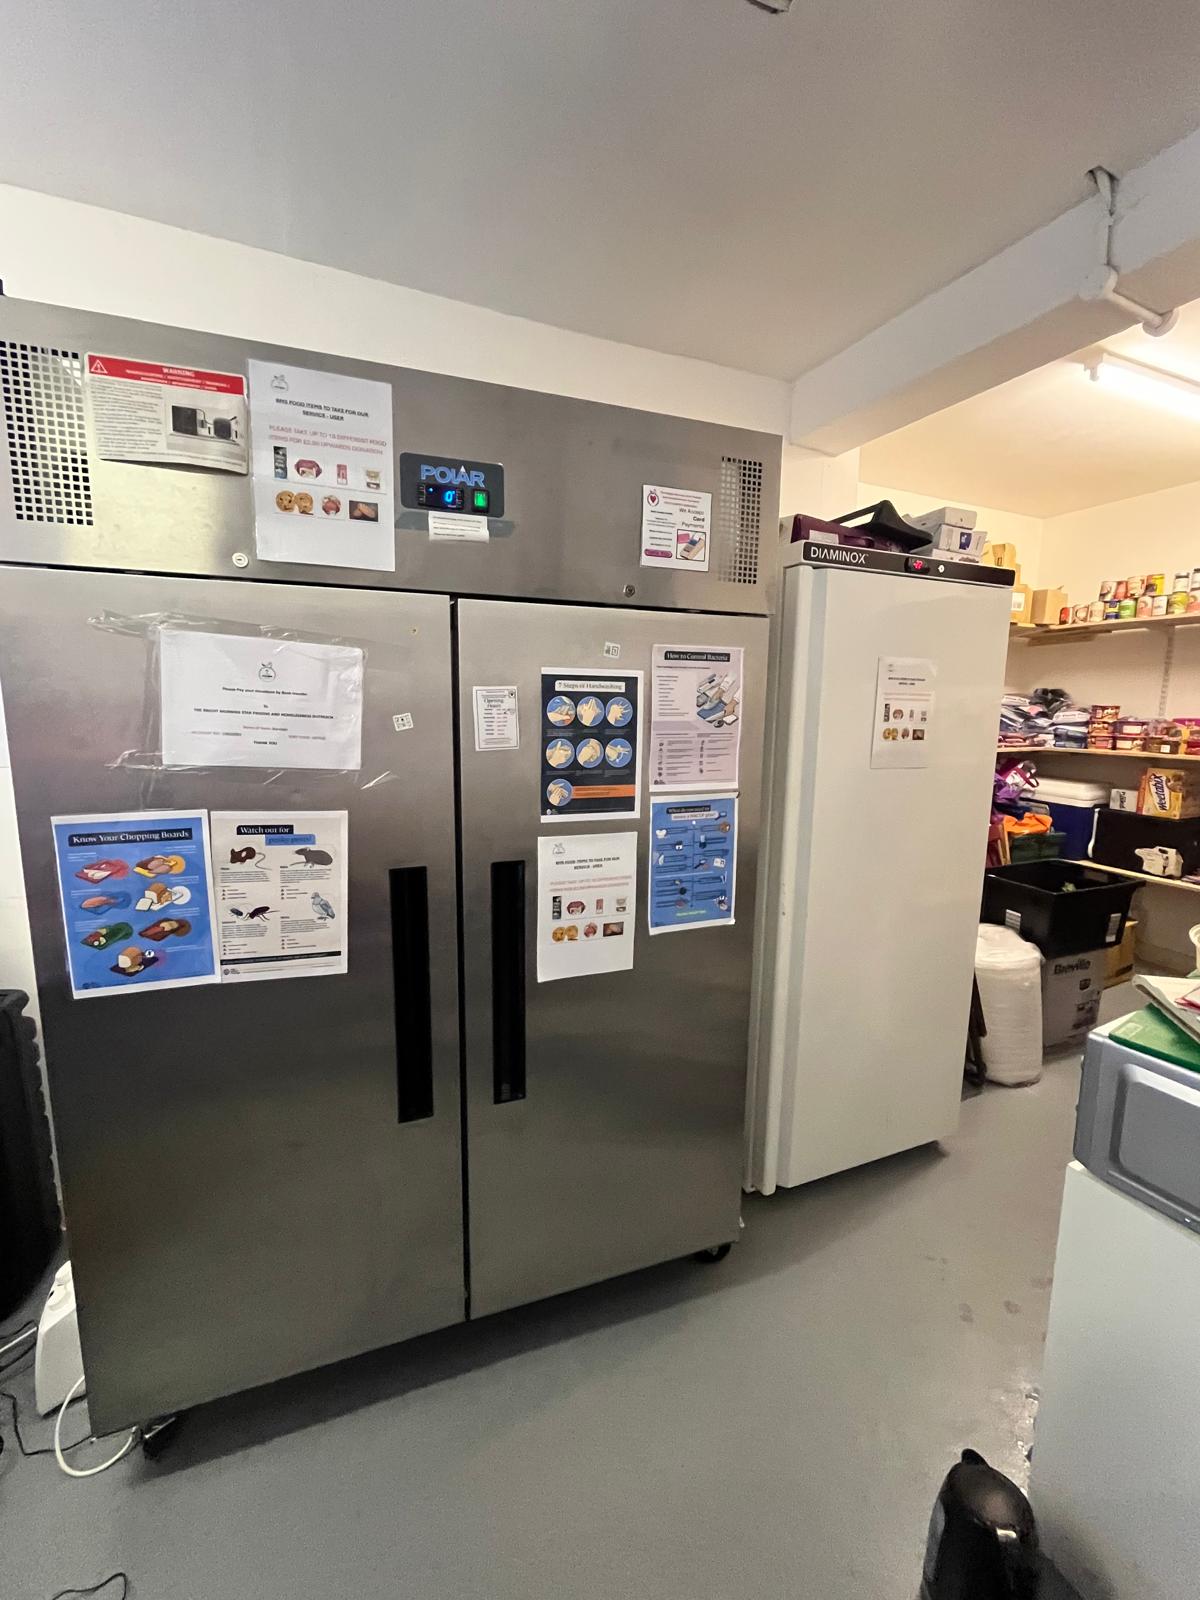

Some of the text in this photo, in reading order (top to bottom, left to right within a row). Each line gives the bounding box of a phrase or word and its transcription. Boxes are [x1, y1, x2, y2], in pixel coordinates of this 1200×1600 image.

[289, 400, 305, 408] FOOD
[306, 402, 322, 410] ITEMS
[332, 406, 344, 414] TAKE
[302, 410, 326, 419] SERVICE
[269, 424, 292, 434] PLEASE
[294, 428, 307, 436] TAKE
[310, 429, 318, 437] UP
[420, 464, 486, 488] POLAR
[810, 547, 866, 564] DIAMINOX
[667, 651, 679, 659] How
[687, 652, 707, 660] Control
[707, 653, 728, 661] Bacteria
[563, 682, 578, 690] Steps
[586, 682, 622, 690] Handwashing
[1151, 773, 1168, 811] Weetabix
[73, 830, 189, 844] Know Your Chopping Boards
[240, 826, 264, 834] Watch
[1054, 958, 1091, 974] Breville
